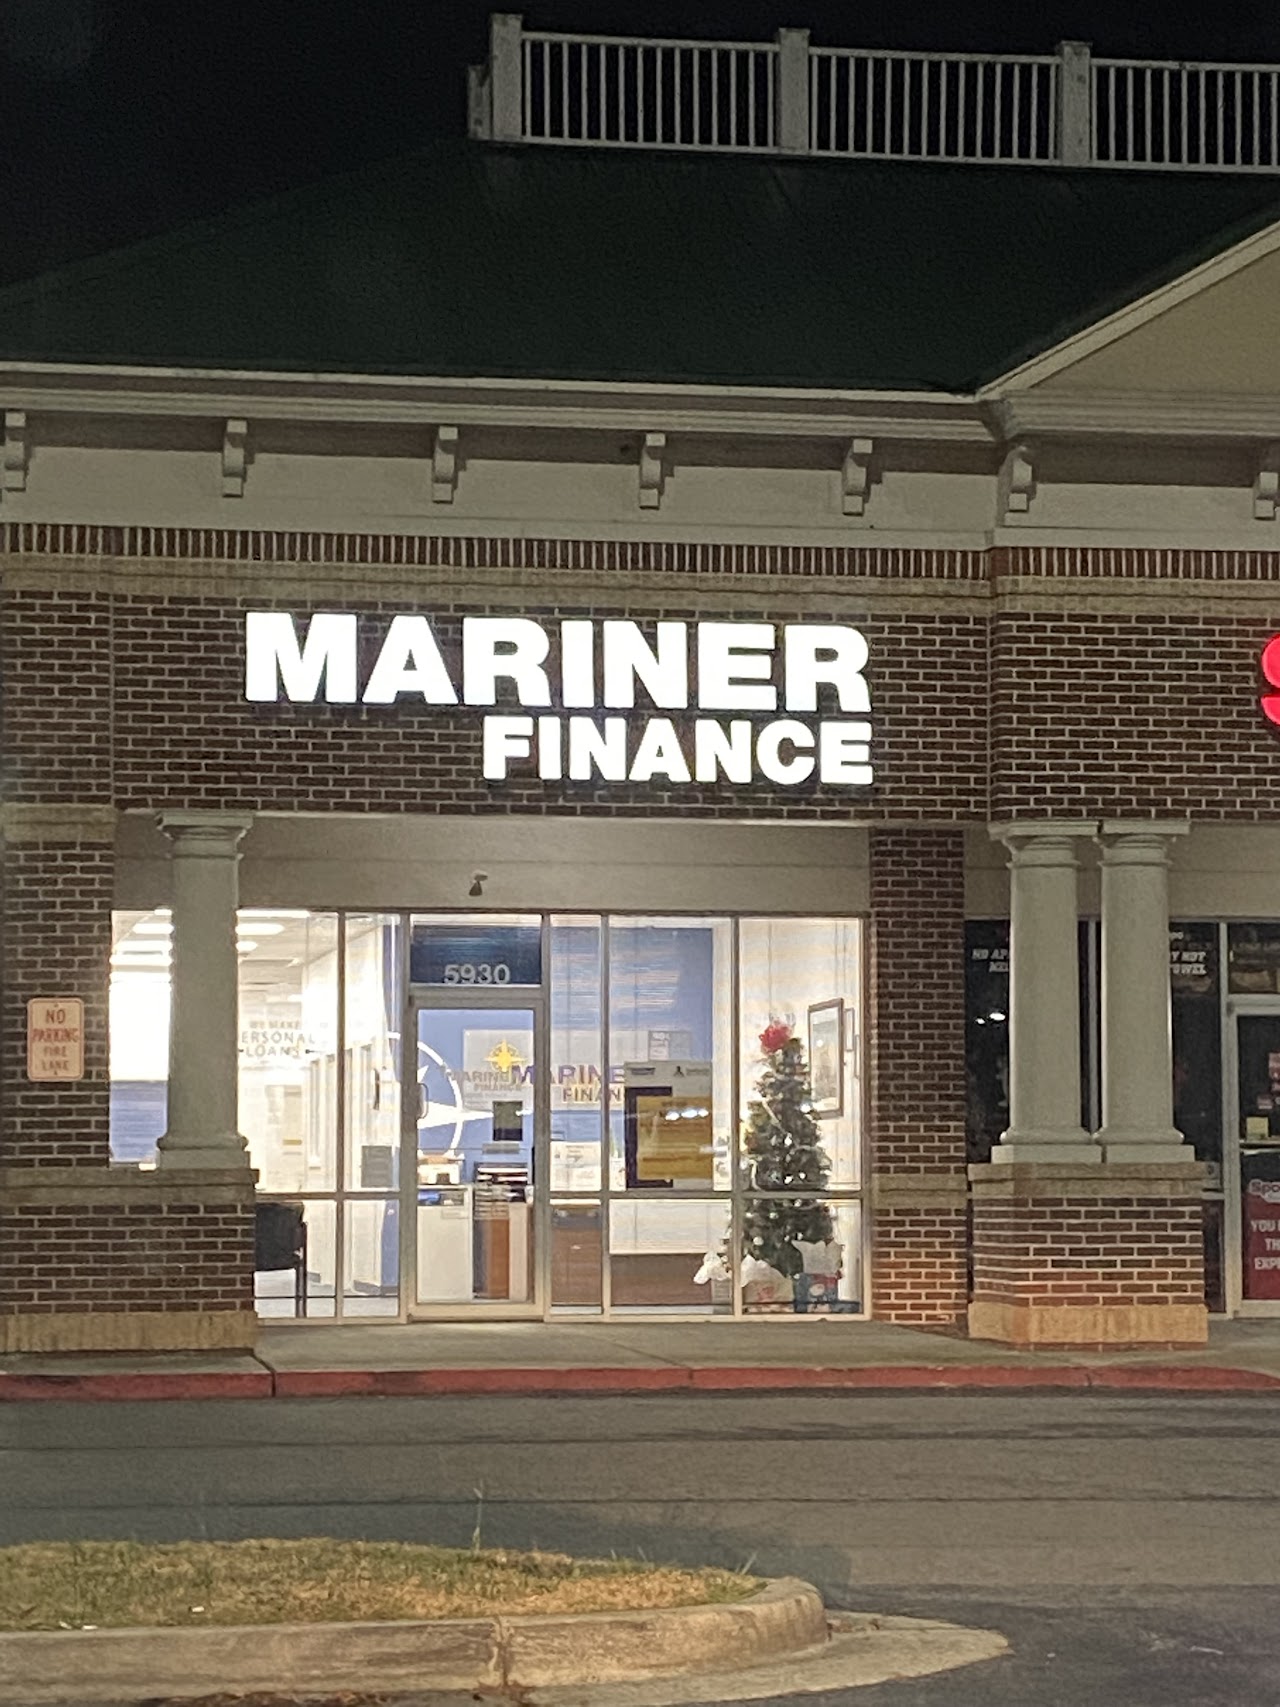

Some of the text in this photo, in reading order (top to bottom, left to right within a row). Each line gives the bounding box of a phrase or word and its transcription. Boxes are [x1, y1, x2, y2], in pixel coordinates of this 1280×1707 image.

[245, 612, 872, 712] MARINER
[483, 716, 873, 784] FINANCE
[443, 963, 511, 985] 5930
[45, 1009, 66, 1024] NO
[32, 1028, 79, 1042] PARKING
[241, 1031, 316, 1044] ERSONAL
[245, 1044, 302, 1059] LOANS
[41, 1060, 69, 1071] LANE
[1264, 1238, 1280, 1252] TH
